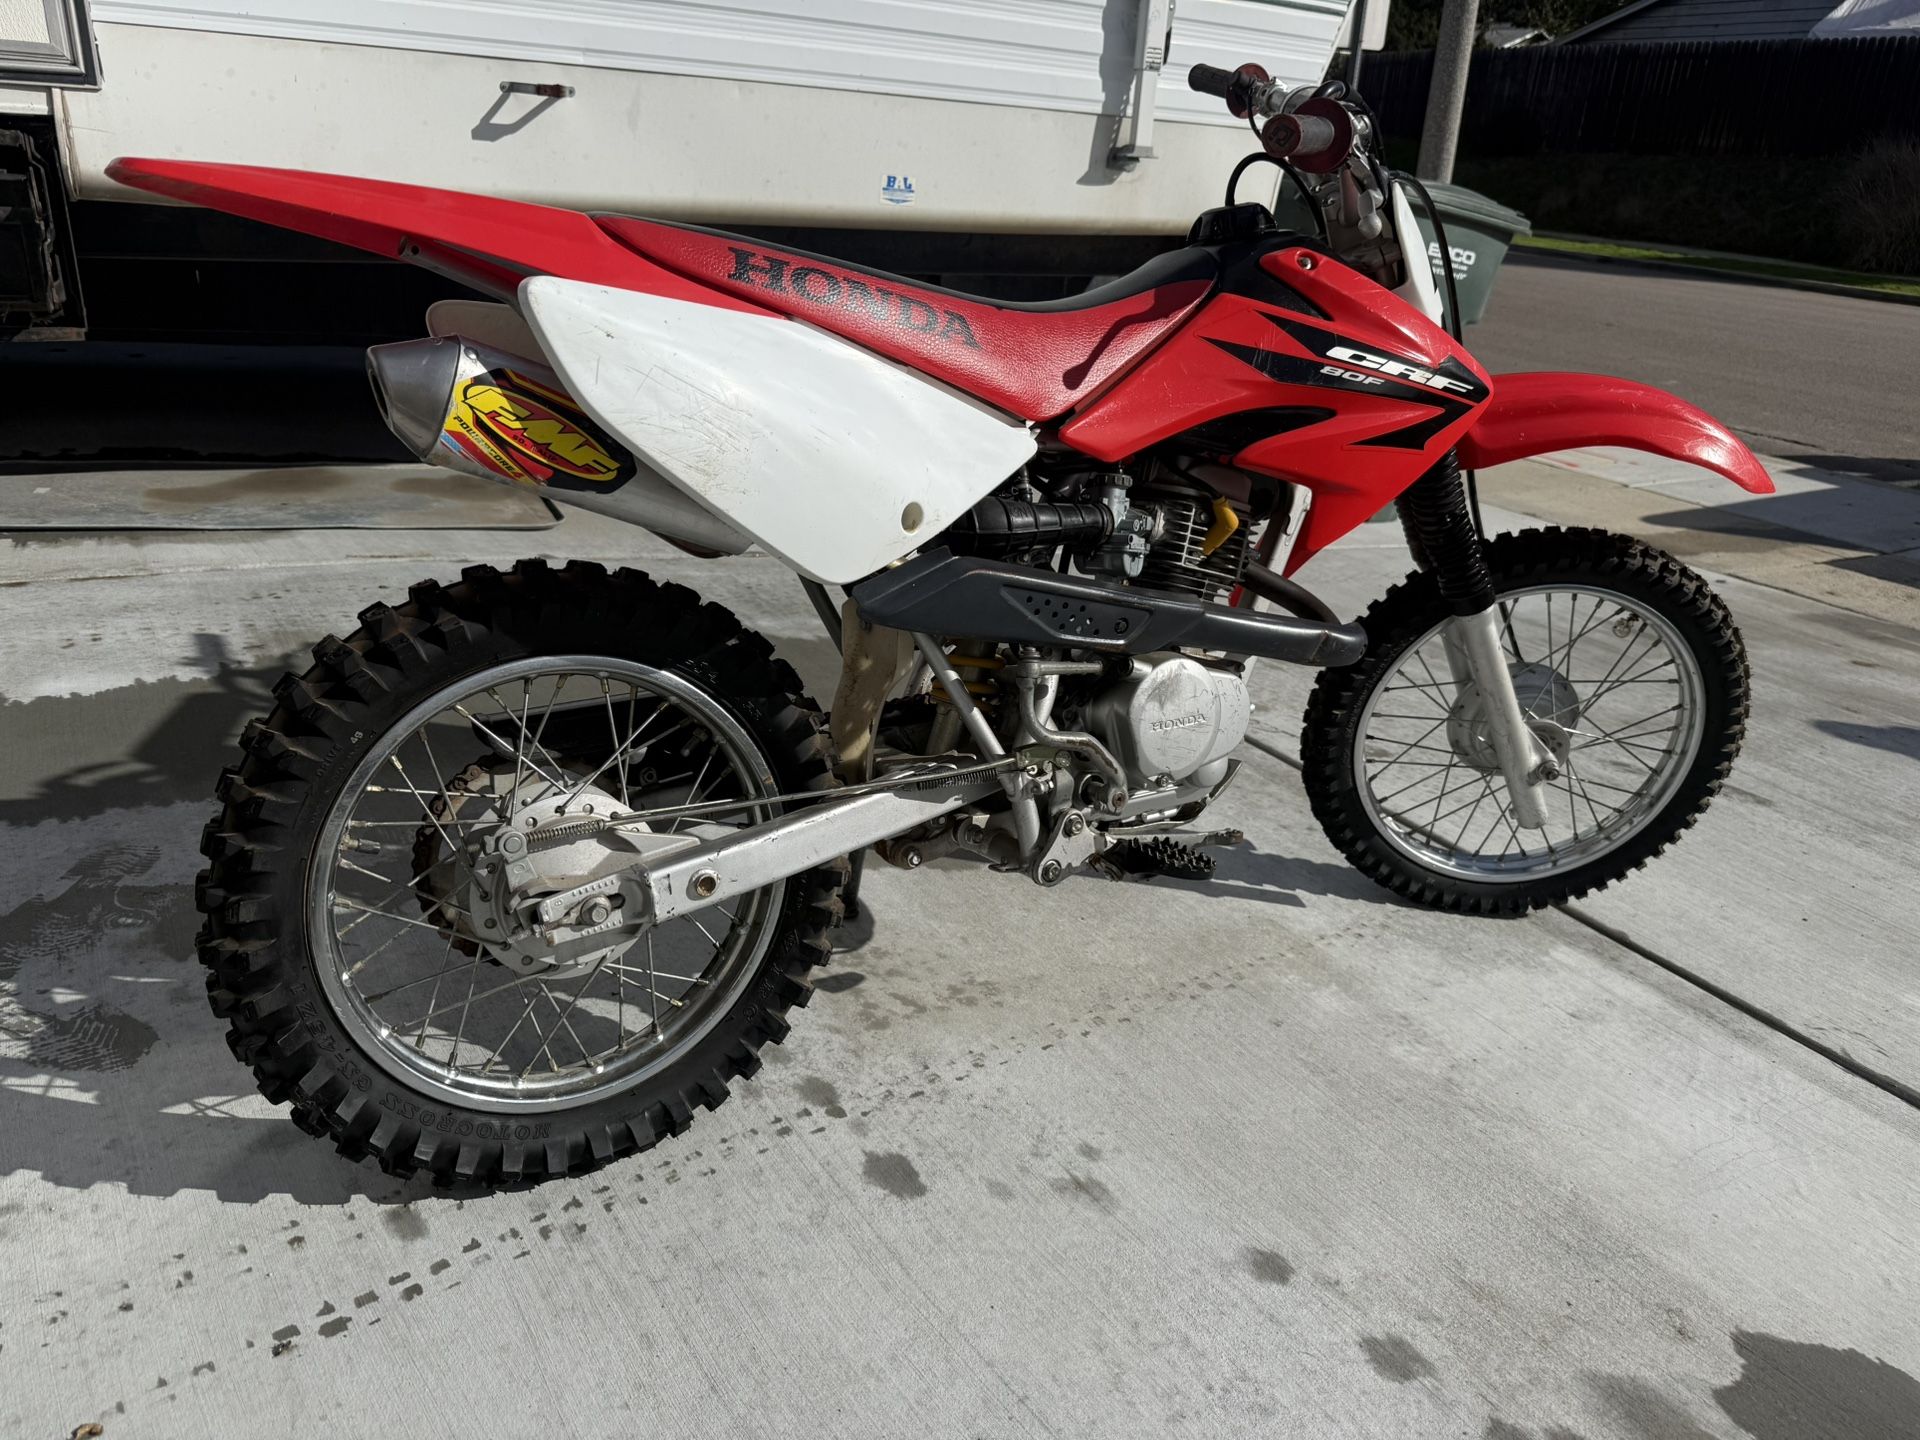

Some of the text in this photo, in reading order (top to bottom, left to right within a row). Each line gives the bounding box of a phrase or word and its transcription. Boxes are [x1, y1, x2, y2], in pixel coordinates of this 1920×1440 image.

[1428, 241, 1476, 265] ECO
[727, 246, 983, 350] HONDA
[1320, 365, 1386, 386] 80F
[1326, 346, 1474, 393] CRF
[461, 388, 621, 474] FMF
[1149, 713, 1206, 732] HONDA
[379, 1092, 552, 1140] MOTOCROSS
